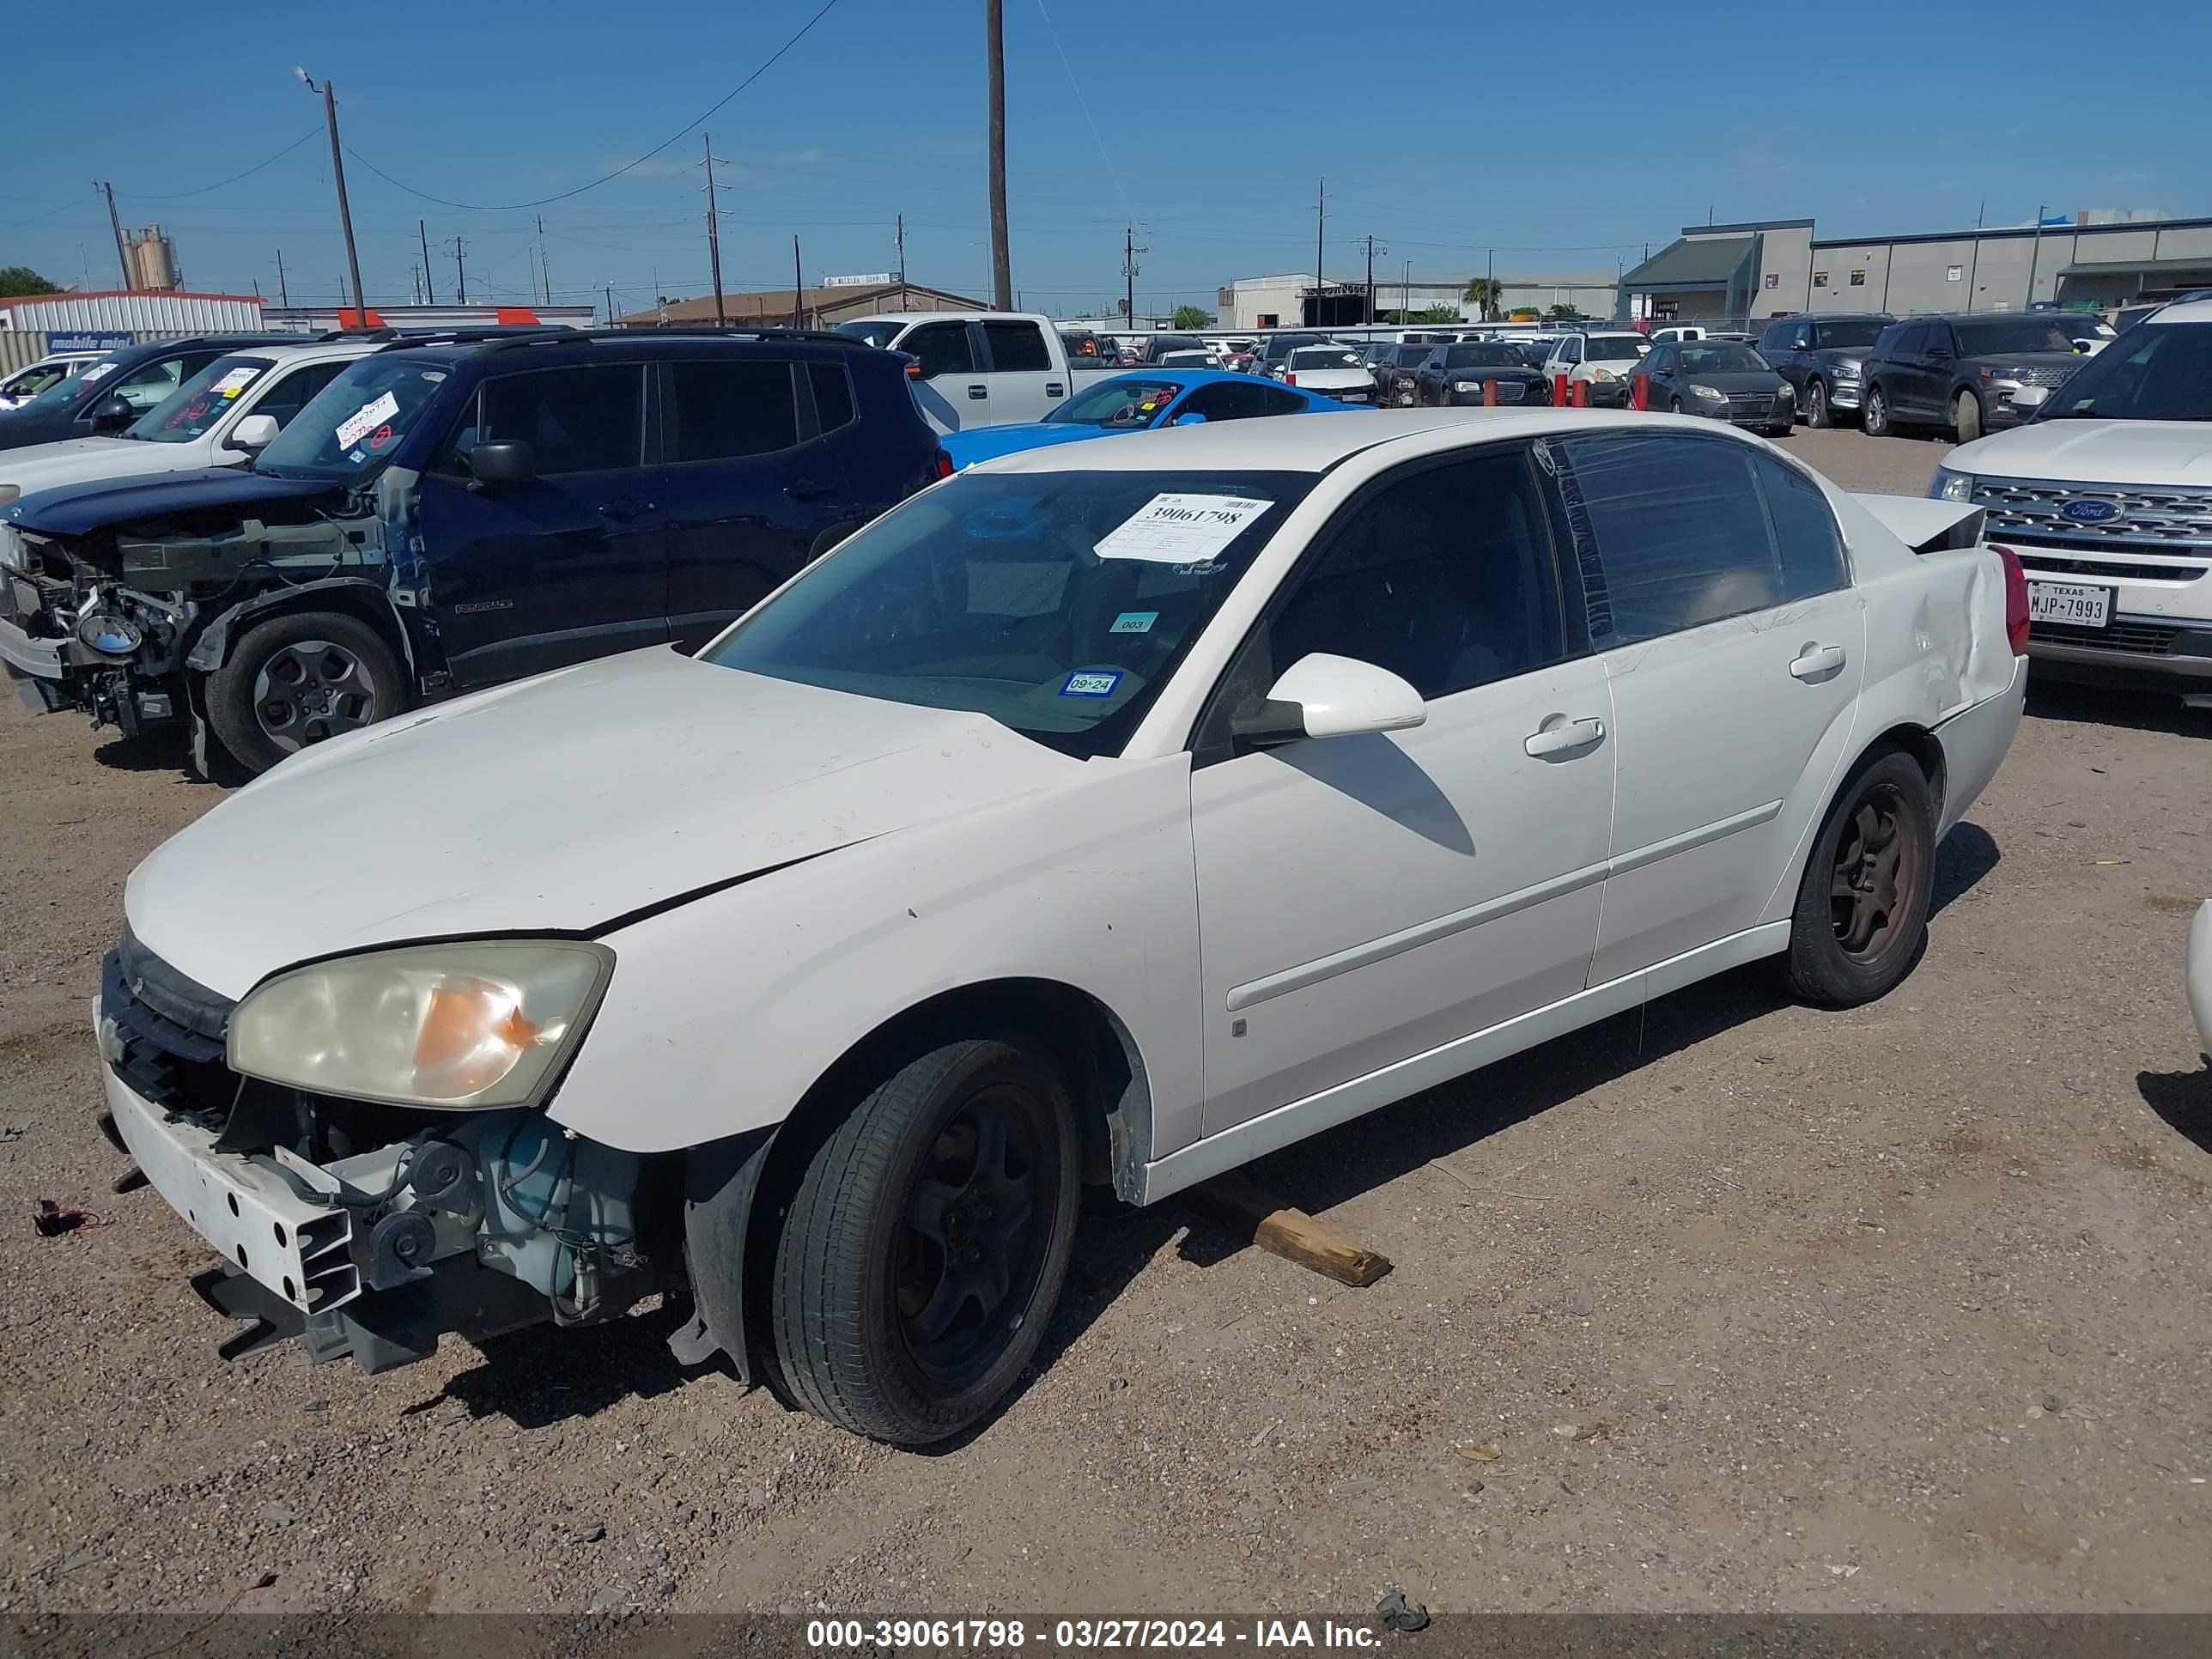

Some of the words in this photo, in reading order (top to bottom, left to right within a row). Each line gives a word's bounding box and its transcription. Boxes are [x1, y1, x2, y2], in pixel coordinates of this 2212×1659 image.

[52, 335, 98, 349] mobile
[1146, 507, 1243, 525] 39061798
[2071, 502, 2106, 517] Ford
[2053, 586, 2084, 597] TEXAS
[1121, 621, 1144, 629] 003
